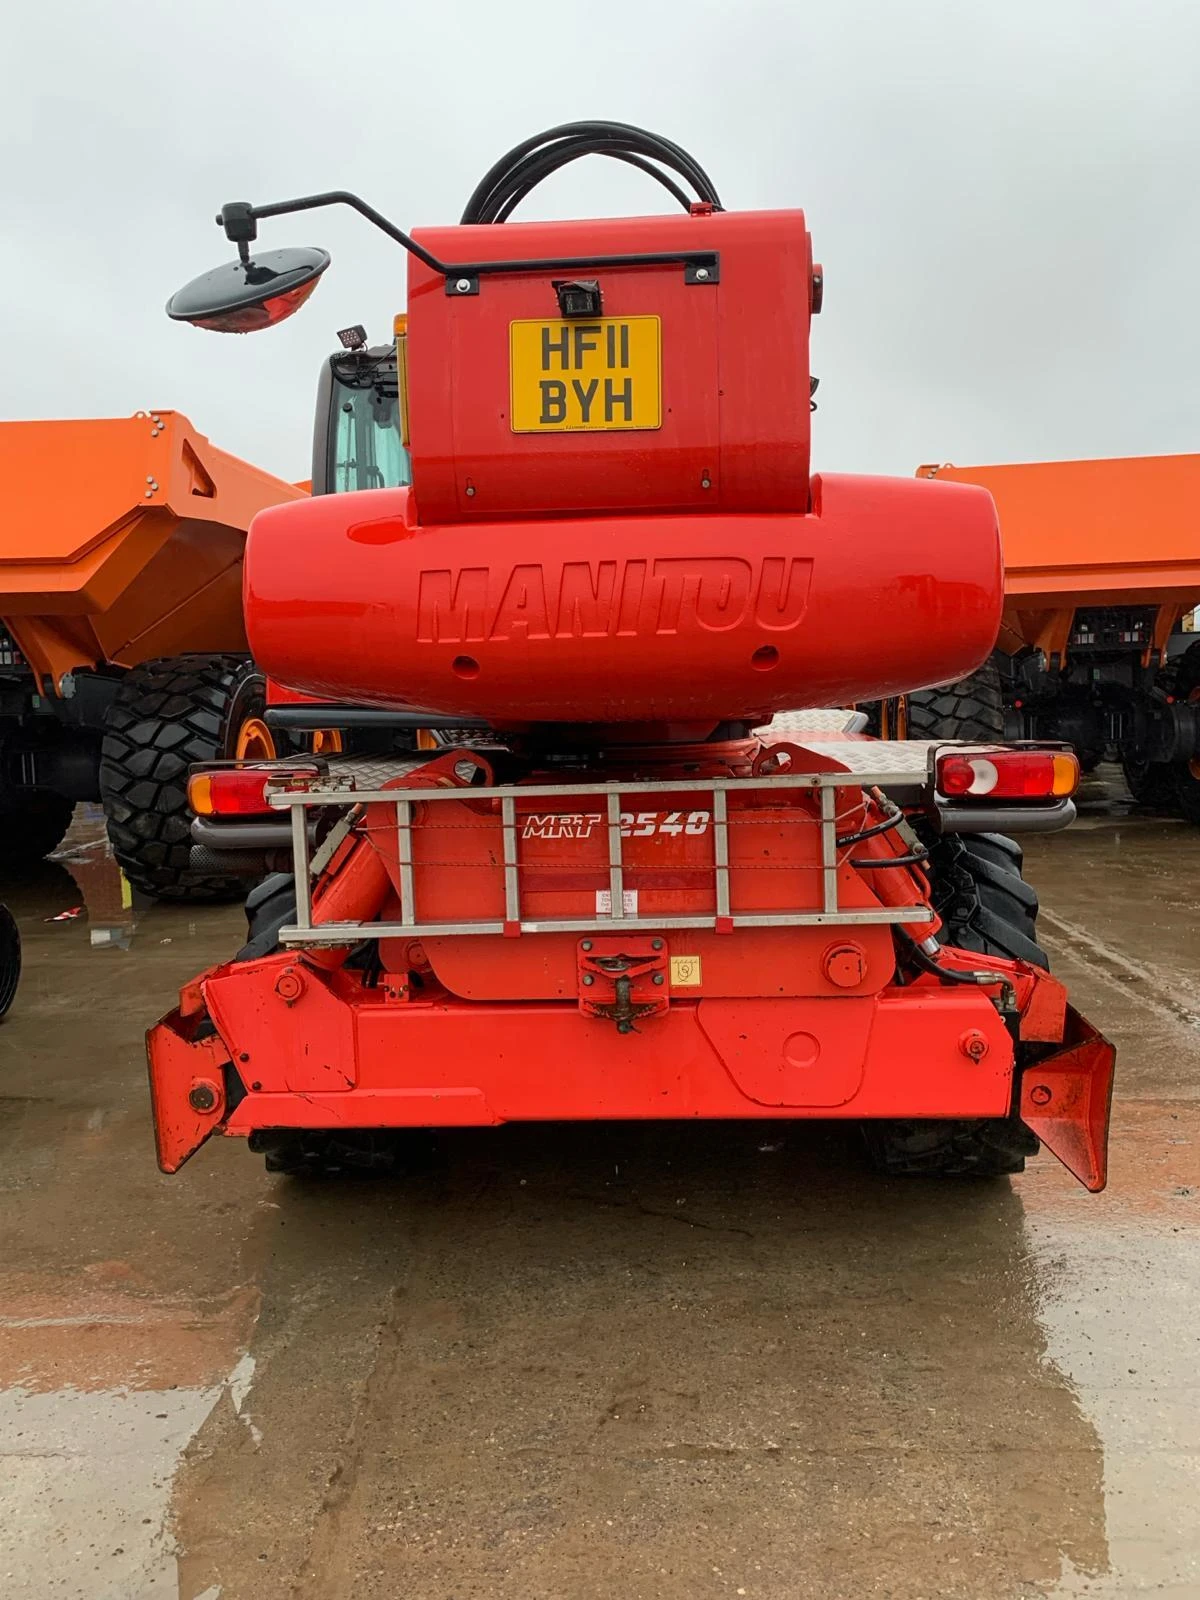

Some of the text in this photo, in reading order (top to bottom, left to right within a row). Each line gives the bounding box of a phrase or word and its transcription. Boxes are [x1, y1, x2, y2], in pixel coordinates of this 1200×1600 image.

[541, 324, 629, 371] HF11
[539, 378, 632, 424] BYH
[416, 556, 814, 643] MANITOU
[522, 811, 710, 839] MRT 2540
